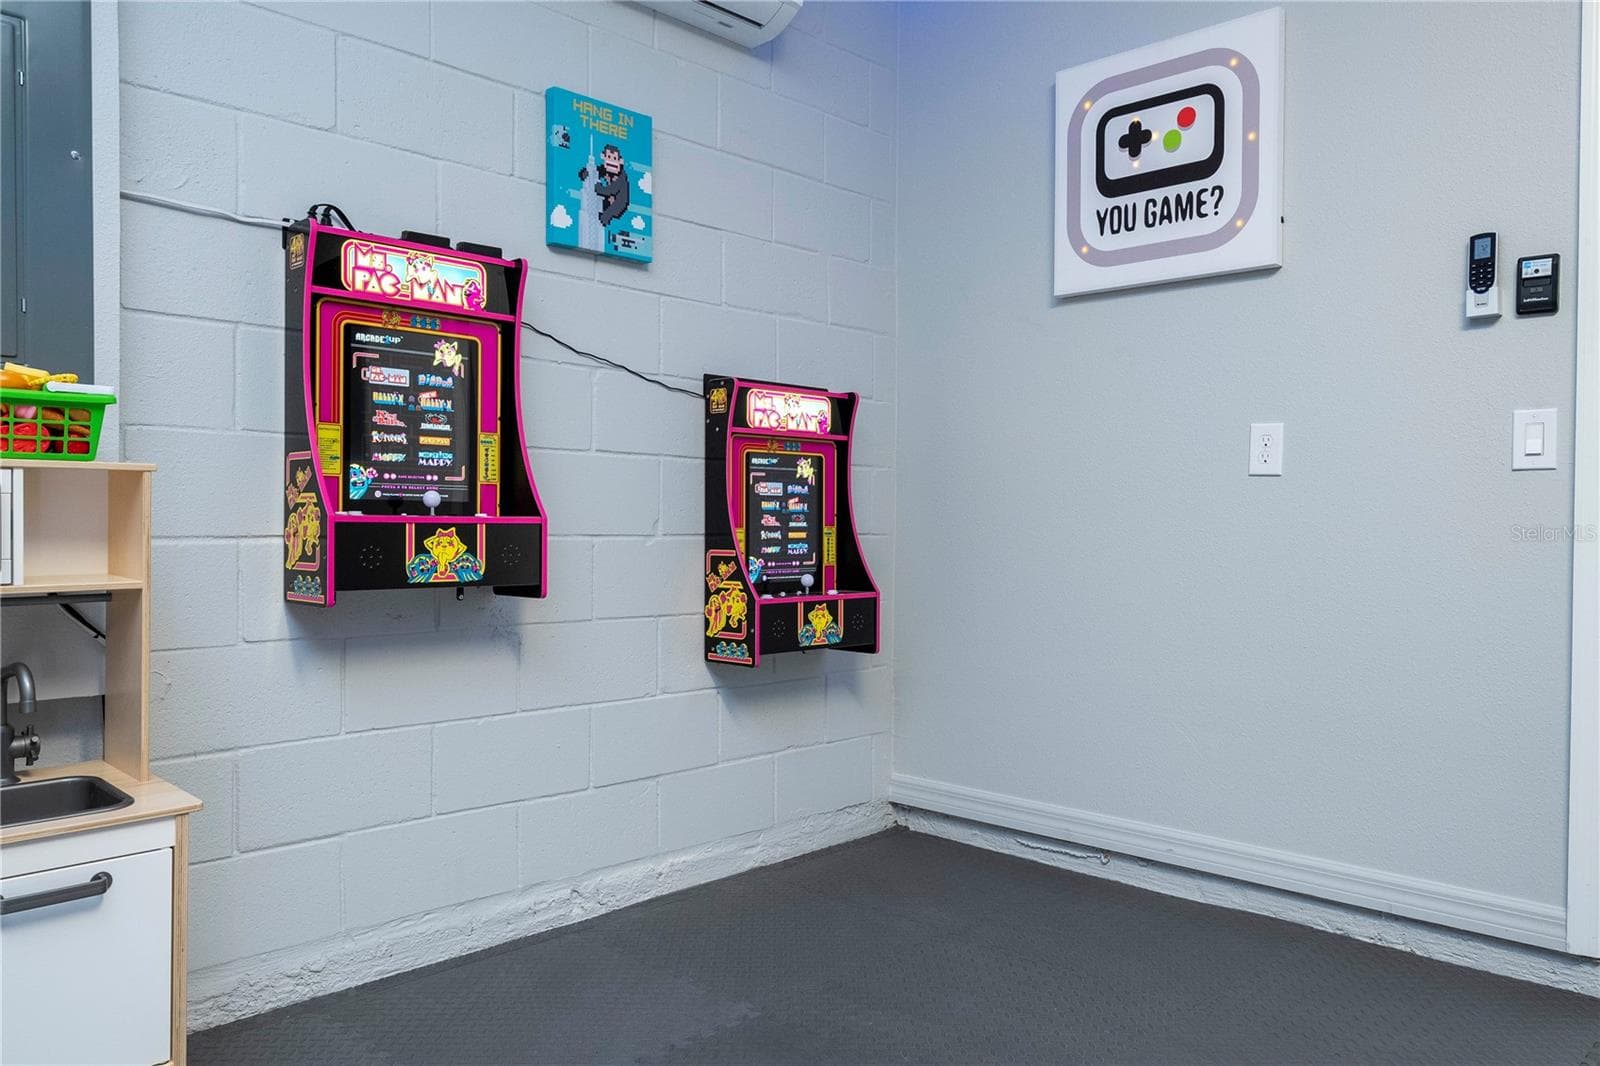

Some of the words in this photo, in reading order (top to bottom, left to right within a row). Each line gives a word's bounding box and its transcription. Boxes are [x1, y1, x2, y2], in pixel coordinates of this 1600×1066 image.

[572, 98, 613, 122] HANG
[618, 112, 634, 128] IN
[579, 113, 628, 140] THERE
[1096, 202, 1137, 237] YOU
[1144, 185, 1225, 229] GAME?
